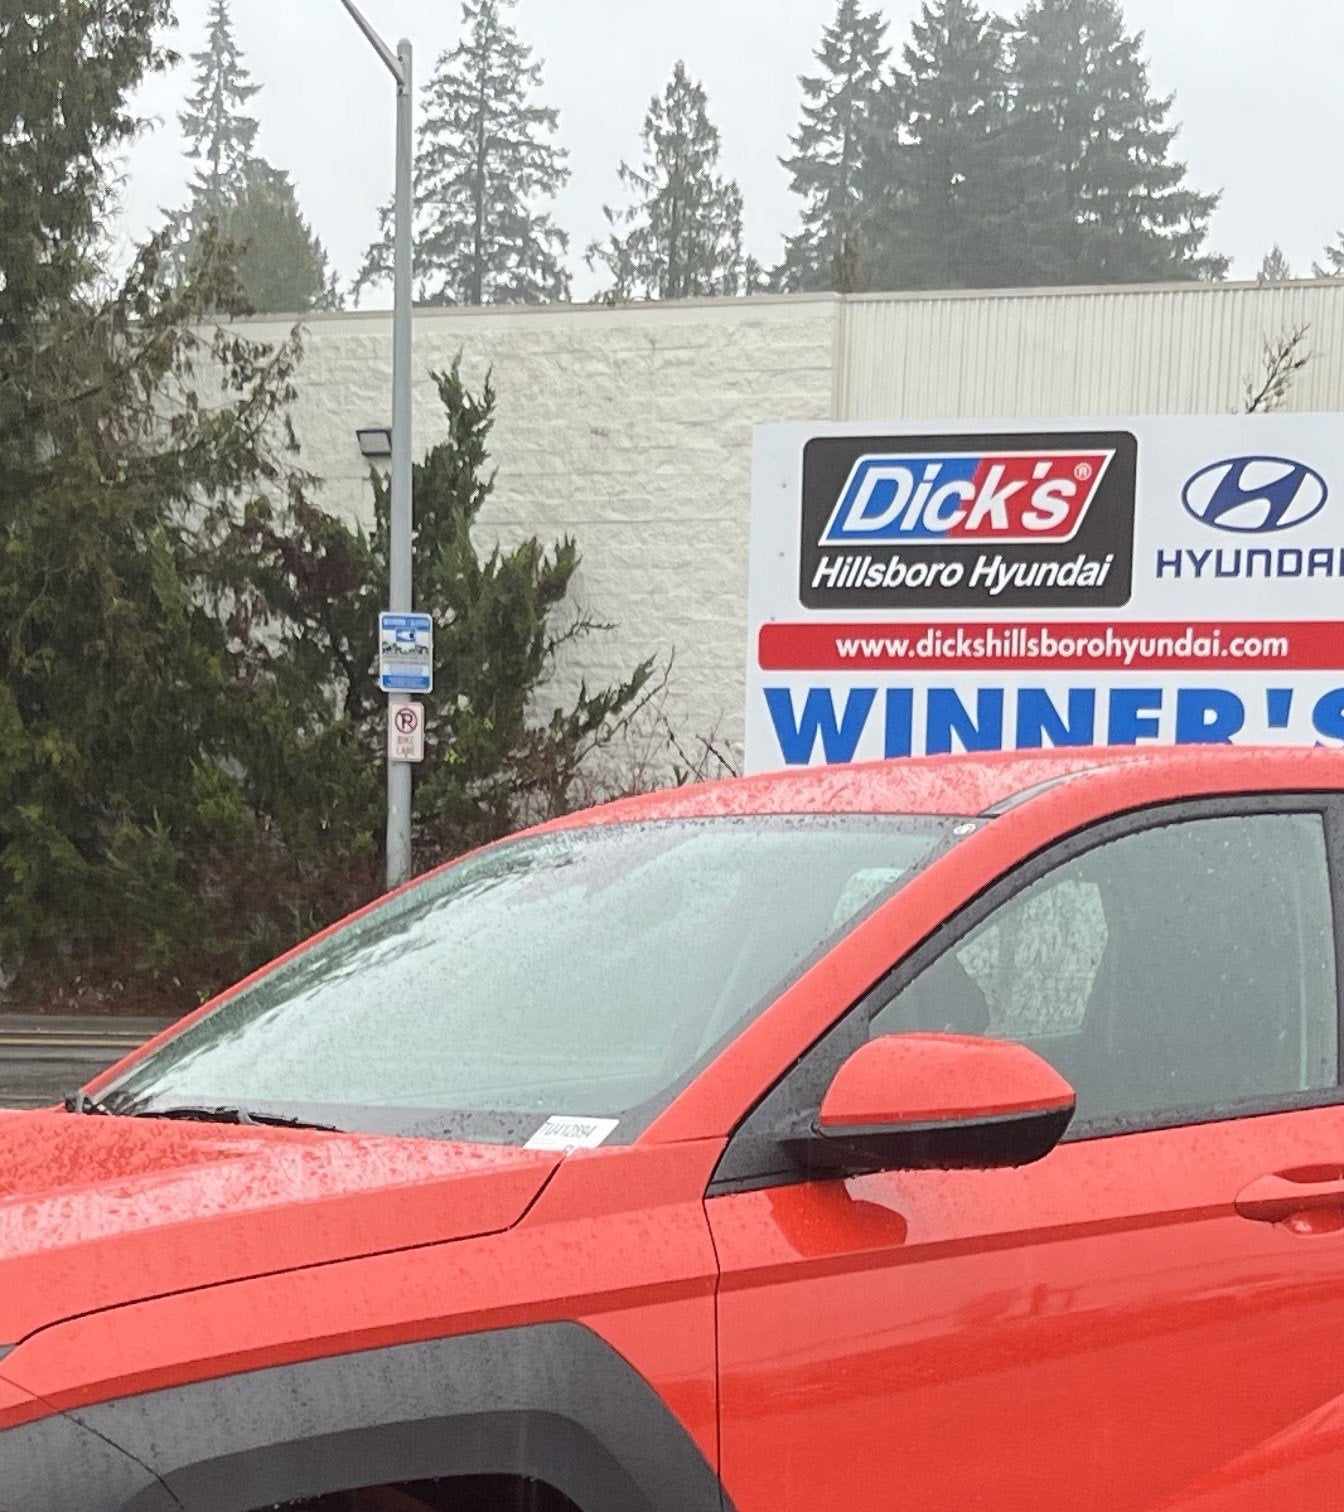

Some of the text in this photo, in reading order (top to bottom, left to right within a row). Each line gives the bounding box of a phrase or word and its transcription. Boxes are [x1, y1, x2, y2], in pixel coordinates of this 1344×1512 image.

[811, 554, 1113, 595] Hillsboro Hyundai
[836, 627, 1289, 663] www.dickshillsborohyundai.com
